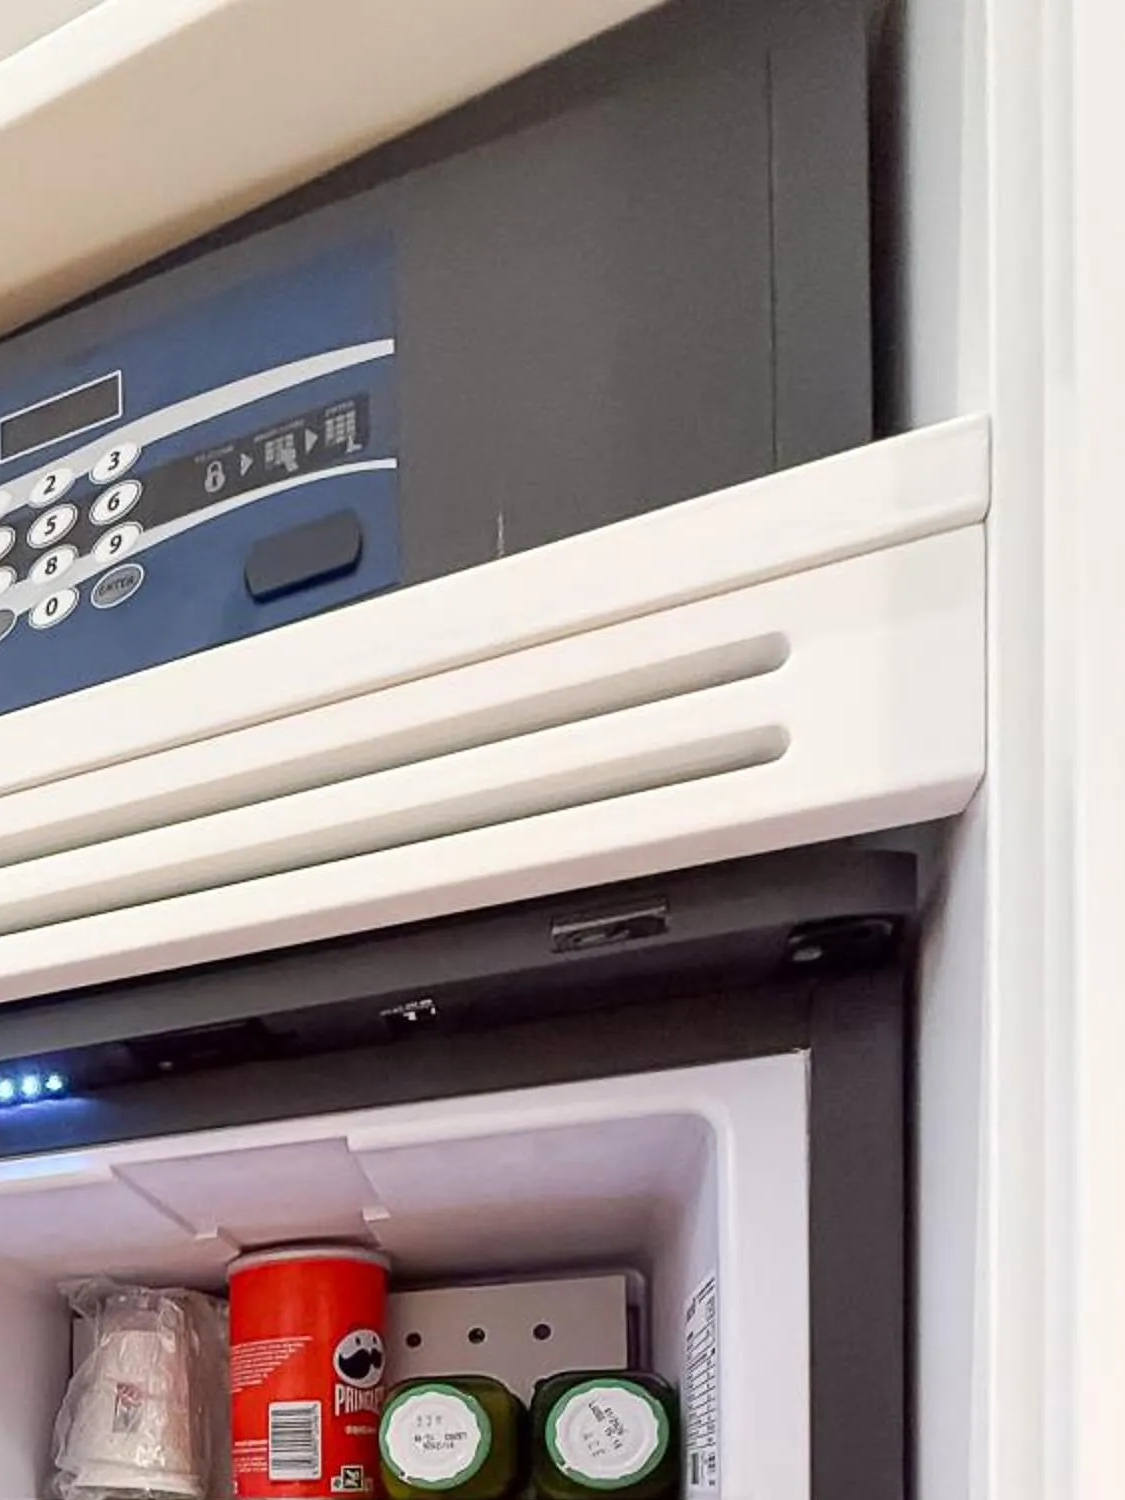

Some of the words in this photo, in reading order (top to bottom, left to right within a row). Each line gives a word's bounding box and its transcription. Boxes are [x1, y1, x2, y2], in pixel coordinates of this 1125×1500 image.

[43, 475, 56, 495] 2
[107, 450, 120, 471] 3
[44, 515, 58, 535] 5
[107, 491, 120, 511] 6
[44, 555, 58, 575] 8
[109, 534, 122, 554] 9
[46, 597, 58, 616] 0
